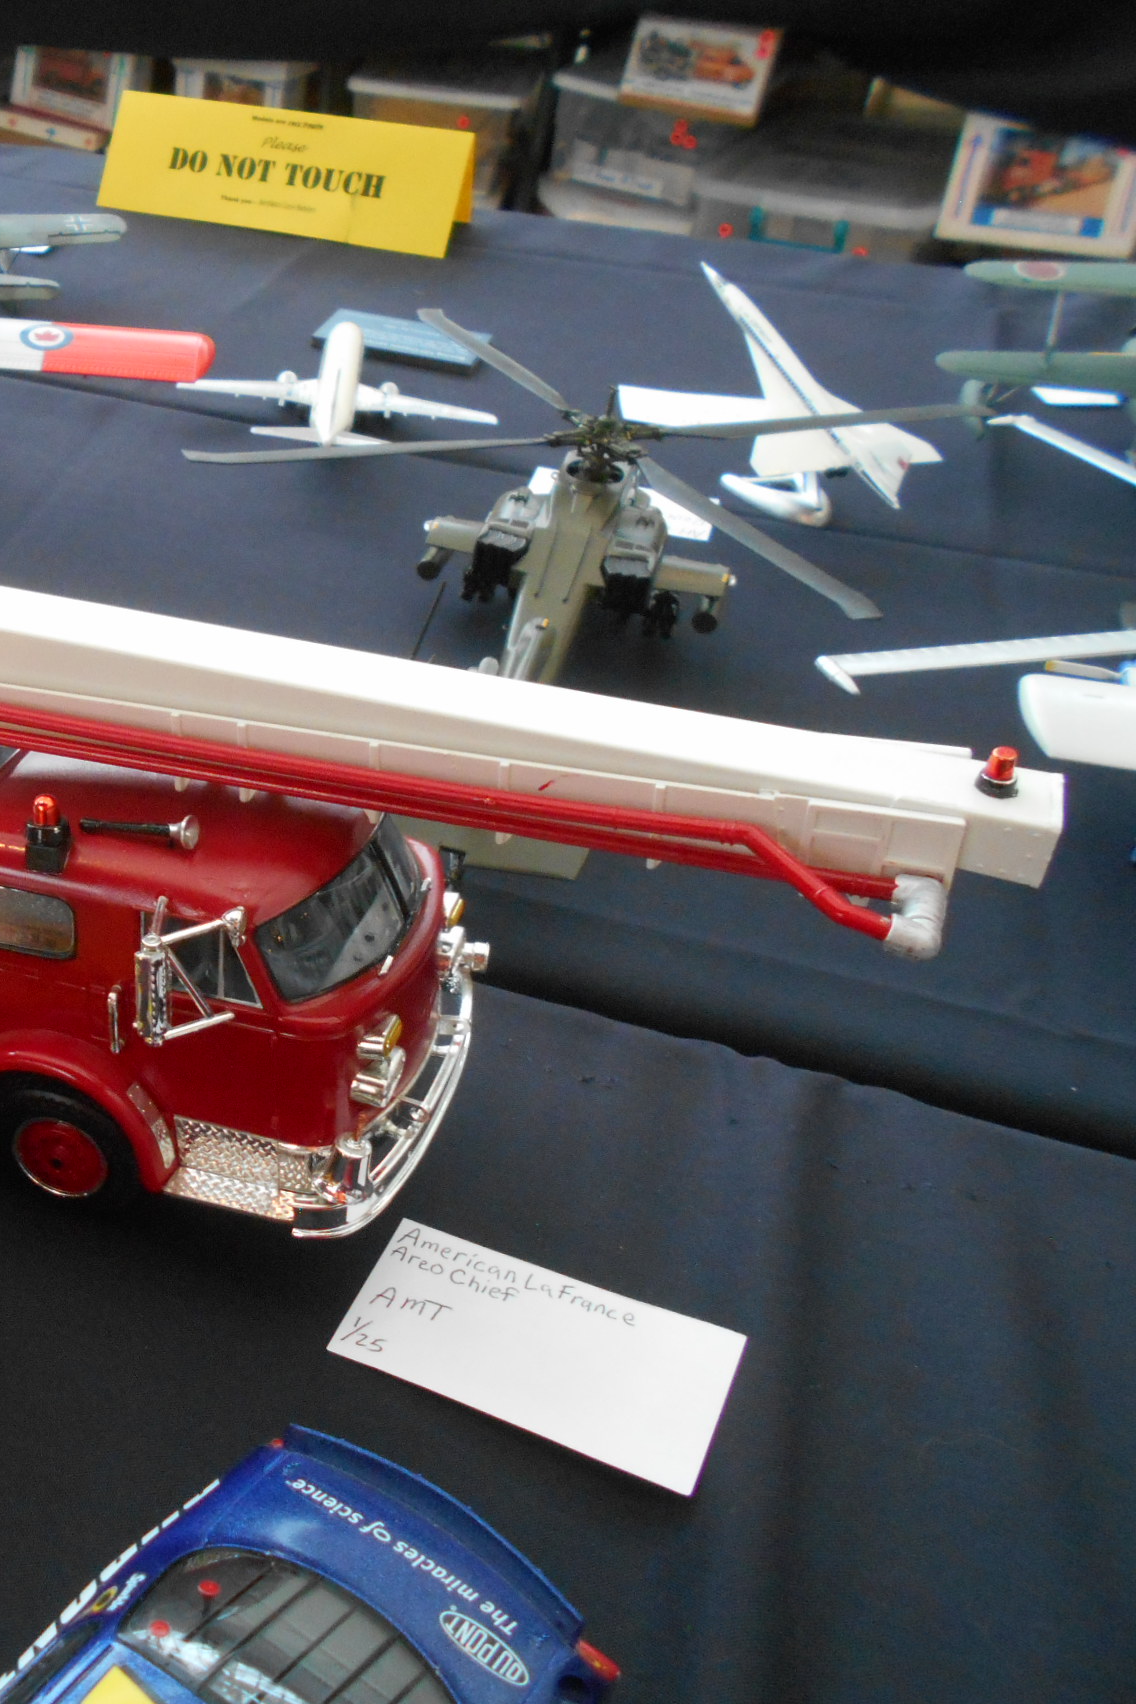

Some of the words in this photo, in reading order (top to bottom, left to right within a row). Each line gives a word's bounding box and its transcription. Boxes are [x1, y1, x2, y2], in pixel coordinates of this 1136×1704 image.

[260, 136, 308, 153] Please
[169, 147, 208, 173] DO
[216, 153, 276, 183] NOT
[285, 162, 386, 199] TOUCH
[390, 1245, 444, 1275] Areo
[450, 1269, 522, 1303] Chief
[397, 1228, 518, 1283] American
[340, 1316, 387, 1353] 1/25
[290, 1478, 365, 1525] science
[358, 1519, 392, 1543] of
[393, 1540, 481, 1602] miracles
[478, 1599, 519, 1637] The
[444, 1615, 525, 1682] DUPONT
